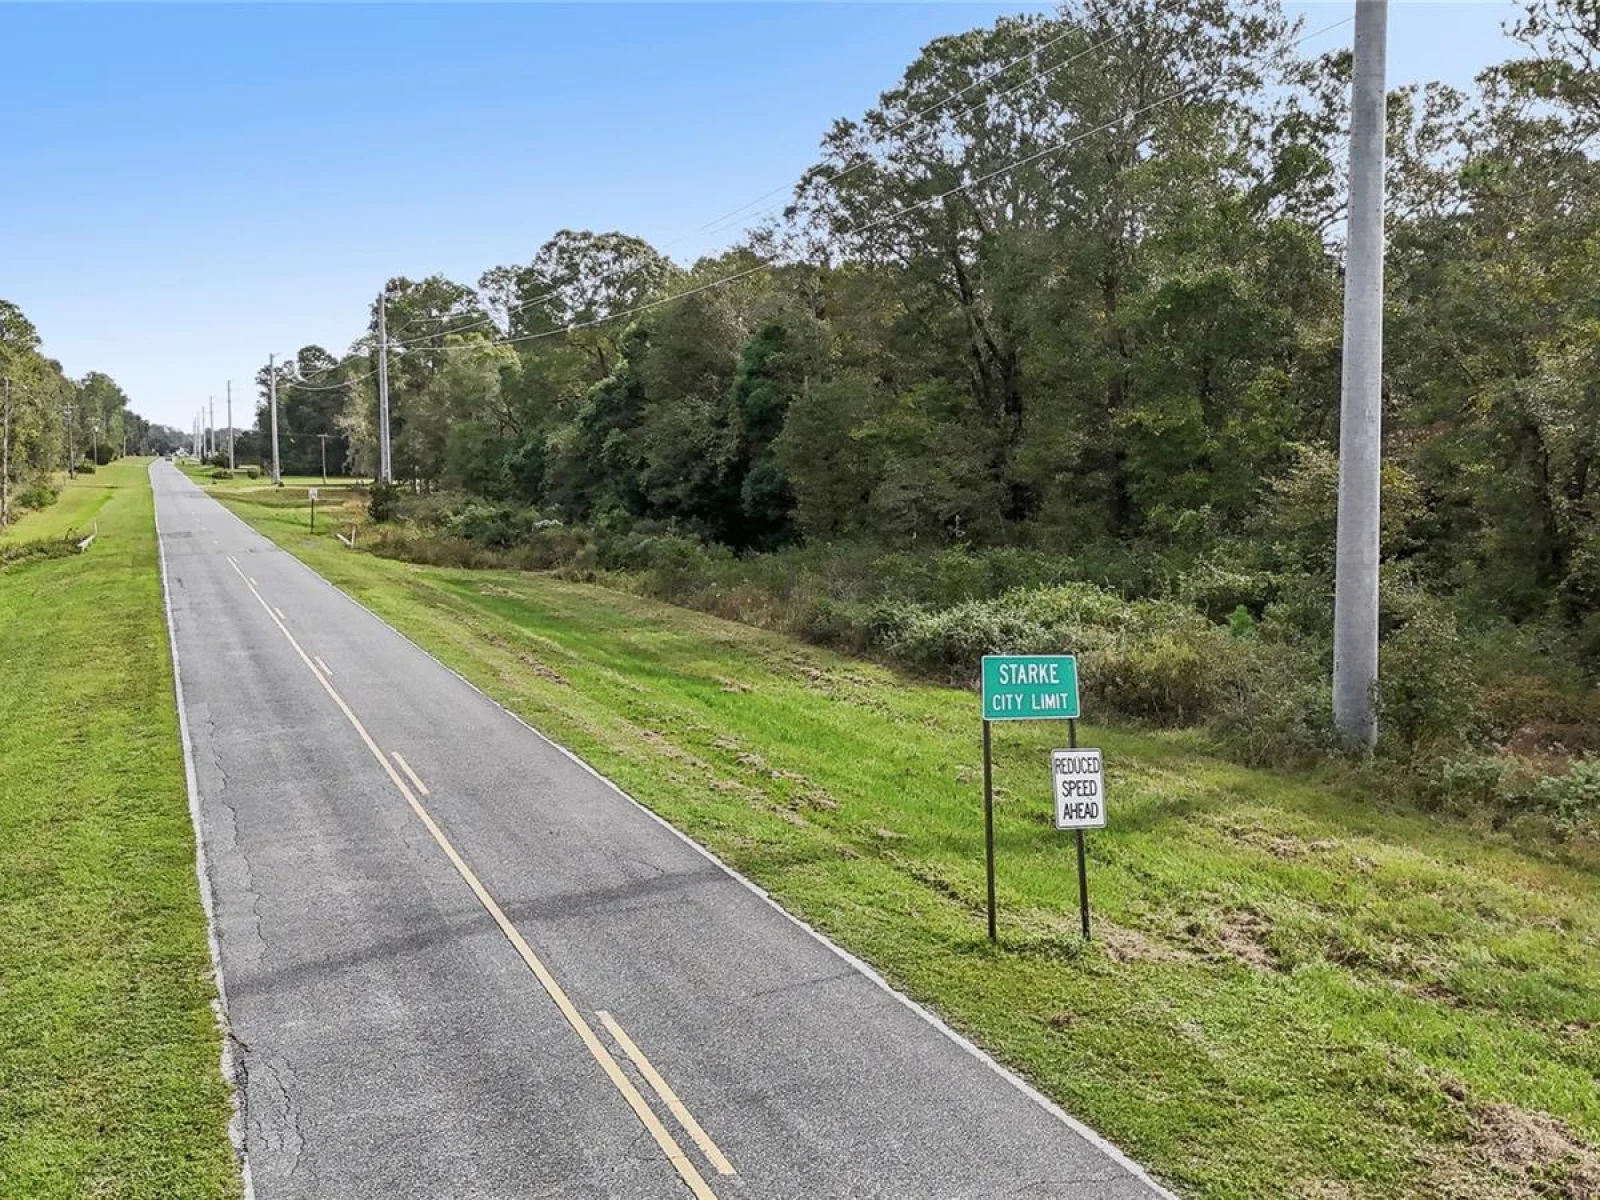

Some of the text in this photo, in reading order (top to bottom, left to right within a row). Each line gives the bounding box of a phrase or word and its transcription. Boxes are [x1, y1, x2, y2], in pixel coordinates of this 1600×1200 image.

[999, 663, 1060, 684] STARKE
[992, 693, 1068, 711] CITY LIMIT
[1055, 757, 1100, 774] REDUCED
[1062, 780, 1097, 797] SPEED
[1063, 802, 1099, 820] AHEAD
